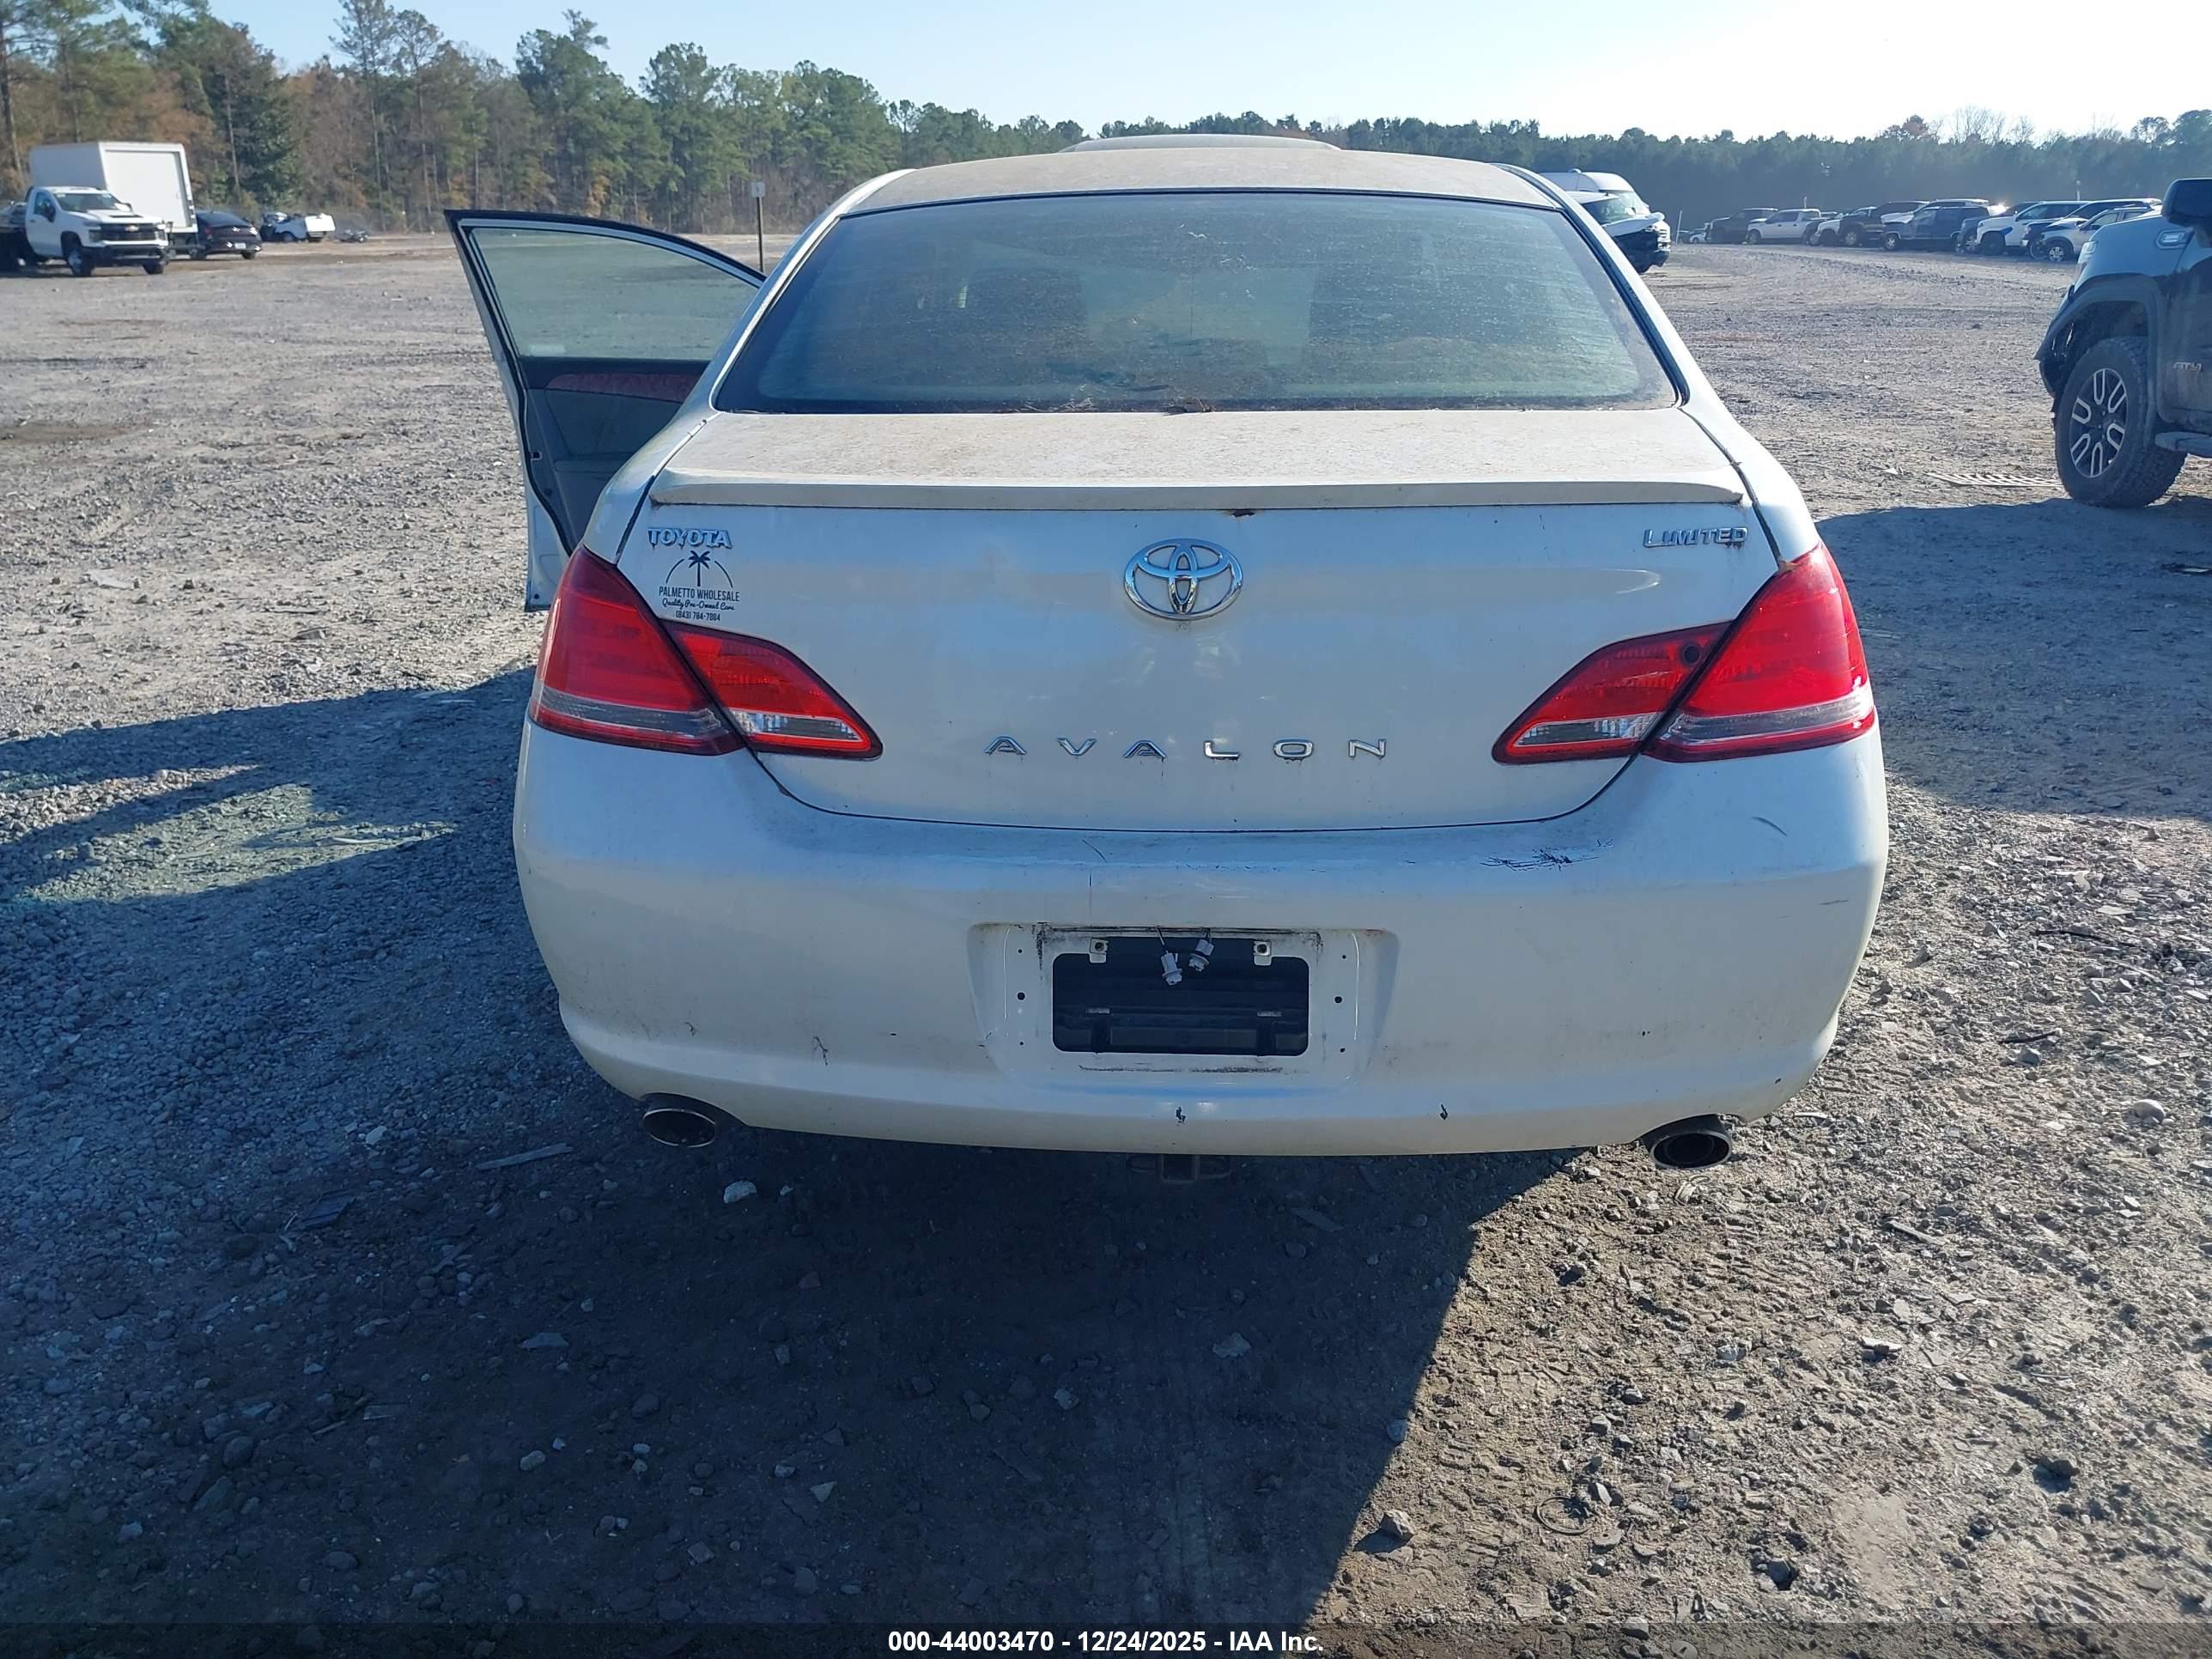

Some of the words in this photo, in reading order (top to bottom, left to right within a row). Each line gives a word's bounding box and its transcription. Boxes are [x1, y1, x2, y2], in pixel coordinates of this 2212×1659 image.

[648, 528, 732, 550] TOYOTA
[1643, 527, 1748, 548] LIMITED
[659, 586, 696, 599] PALMETTO
[696, 588, 740, 602] WHOLESALE
[662, 597, 684, 610] Quality
[984, 735, 1388, 759] AVALON
